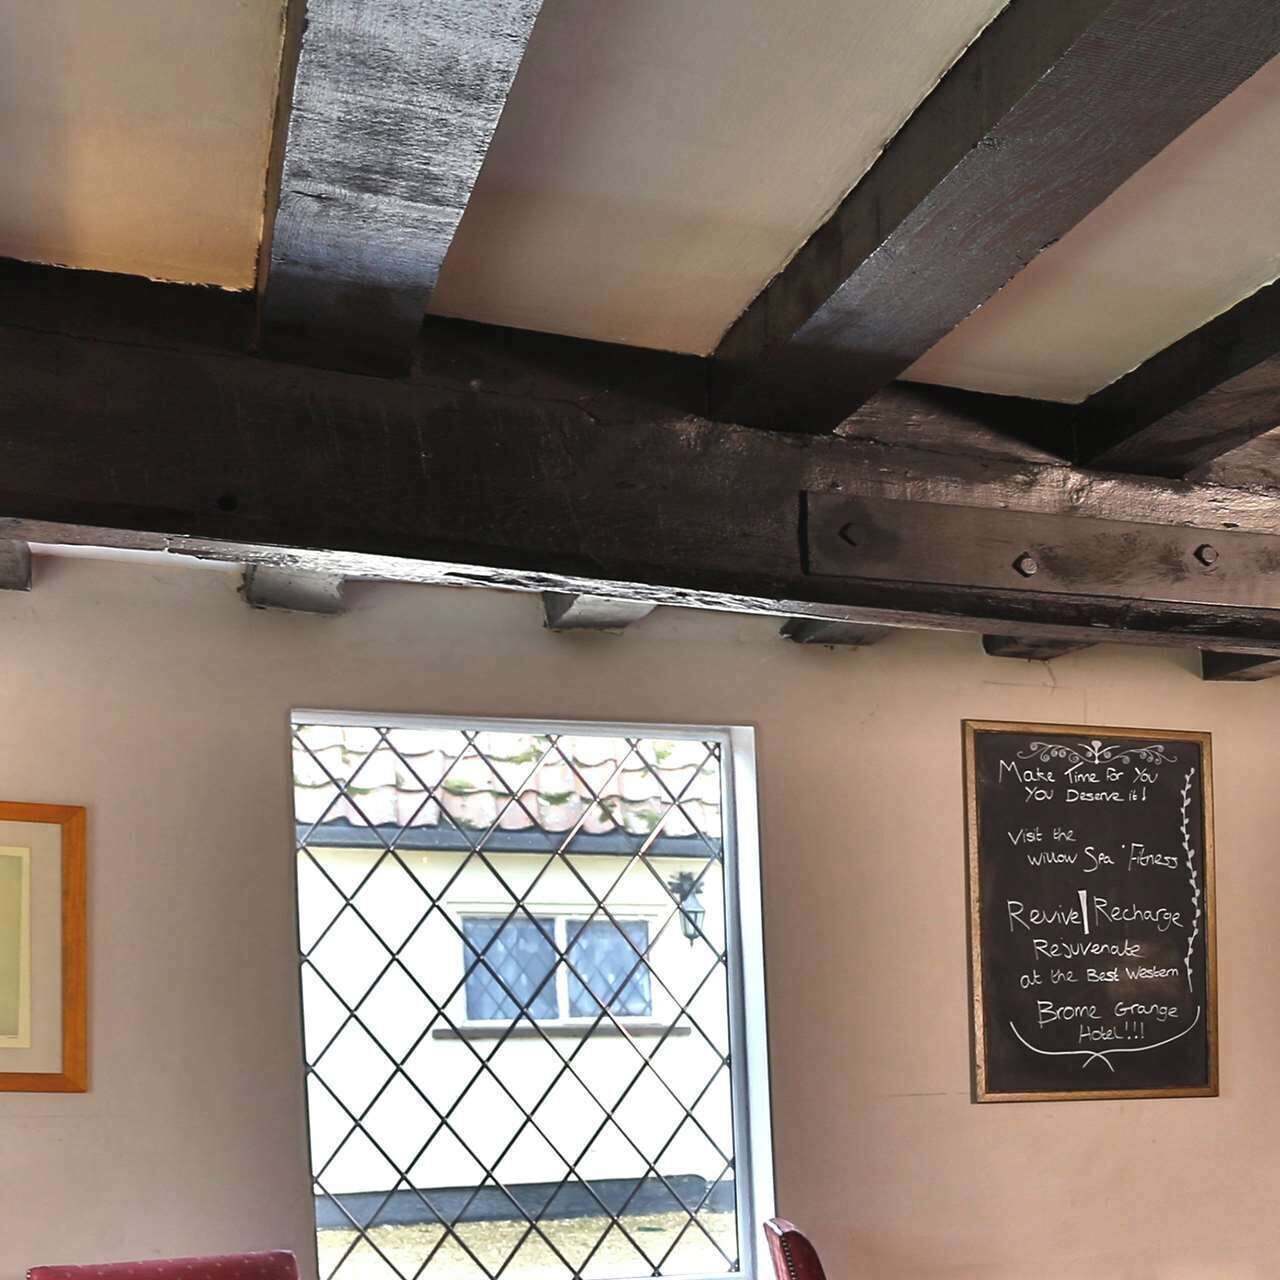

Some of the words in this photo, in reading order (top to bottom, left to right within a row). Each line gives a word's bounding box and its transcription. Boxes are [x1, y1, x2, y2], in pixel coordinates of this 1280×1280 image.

[999, 759, 1056, 783] Make
[1064, 761, 1101, 784] Time
[1132, 767, 1159, 784] You
[1025, 786, 1055, 802] You
[1065, 789, 1125, 802] Deserve
[1008, 826, 1043, 845] Visit
[1052, 827, 1077, 842] the
[1083, 846, 1115, 873] Spa
[1127, 842, 1178, 872] Fitness
[1007, 900, 1082, 932] Revive
[1093, 896, 1184, 932] Recharge
[1033, 936, 1146, 960] Rejuvenate
[1020, 969, 1043, 988] at
[1051, 968, 1079, 984] the
[1086, 967, 1120, 982] Best
[1125, 966, 1179, 980] Western
[1037, 1000, 1102, 1028] Brome
[1114, 1001, 1179, 1022] Grange
